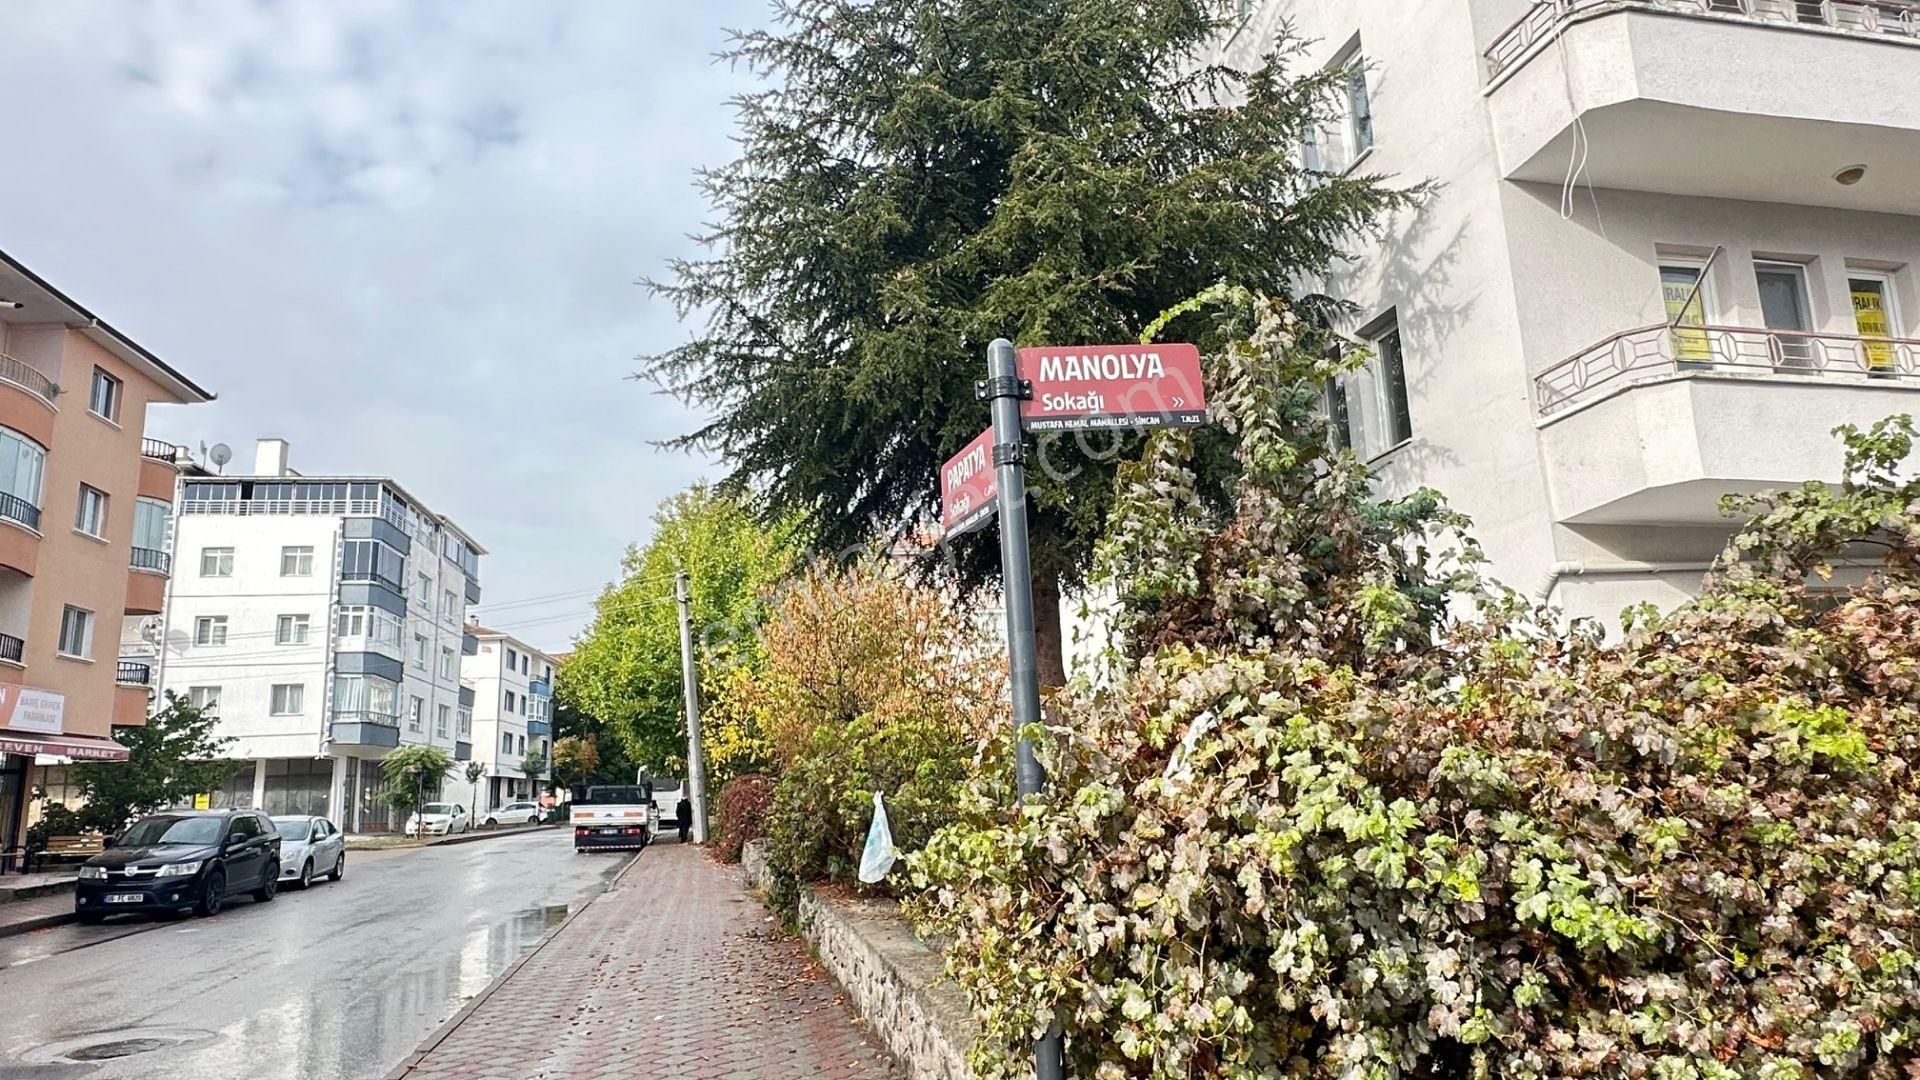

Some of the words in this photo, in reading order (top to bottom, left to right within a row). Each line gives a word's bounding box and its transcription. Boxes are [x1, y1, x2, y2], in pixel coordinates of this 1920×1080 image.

[1039, 353, 1165, 381] MANOLYA
[1042, 391, 1104, 414] Sokağı
[1030, 420, 1064, 430] MUSTAFA
[947, 443, 986, 493] PAPATYA
[67, 747, 117, 759] MARKET
